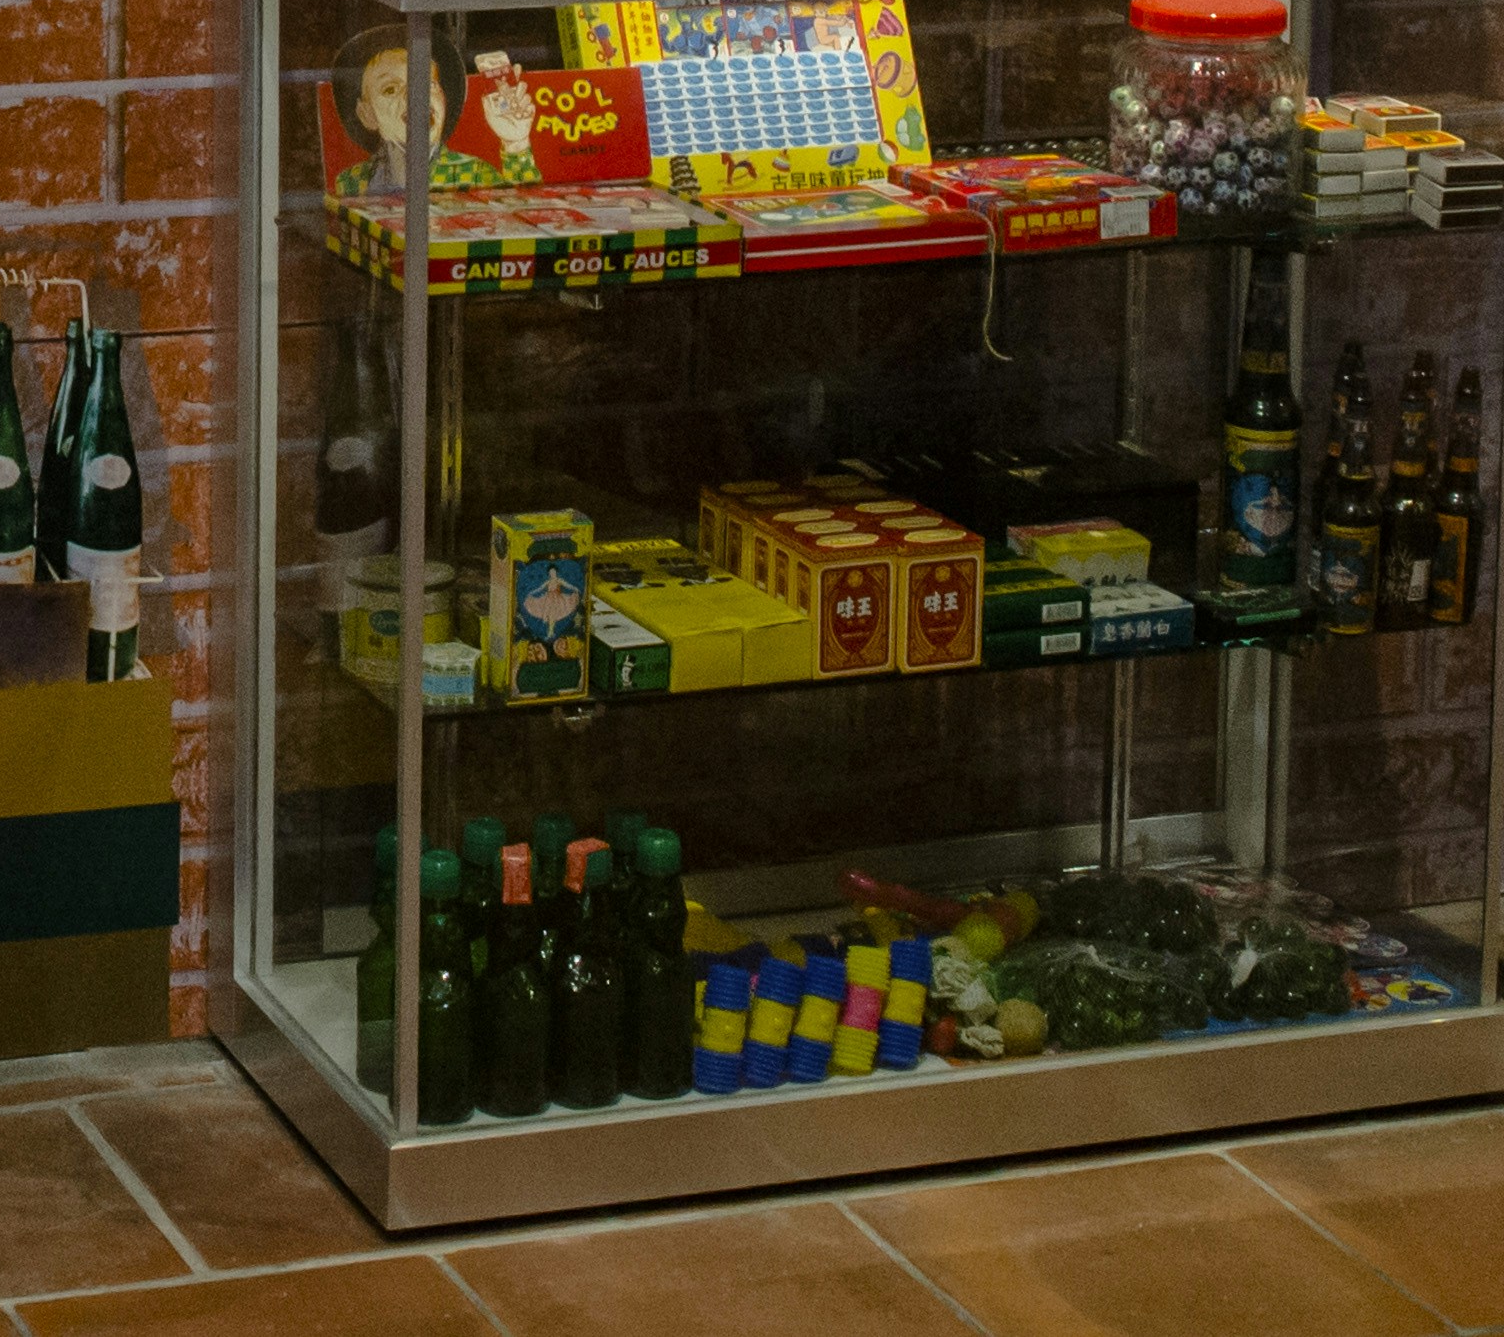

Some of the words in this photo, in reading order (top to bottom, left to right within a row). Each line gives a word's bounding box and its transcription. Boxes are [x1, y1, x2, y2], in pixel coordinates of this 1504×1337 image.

[535, 78, 613, 113] COOL
[535, 111, 620, 143] FAUCES
[559, 143, 608, 158] CANDY
[553, 236, 614, 253] BEST
[451, 259, 532, 281] CANDY
[553, 256, 618, 276] COOL
[623, 248, 711, 271] FAUCES
[837, 596, 872, 620] 味王
[922, 590, 960, 614] 味王
